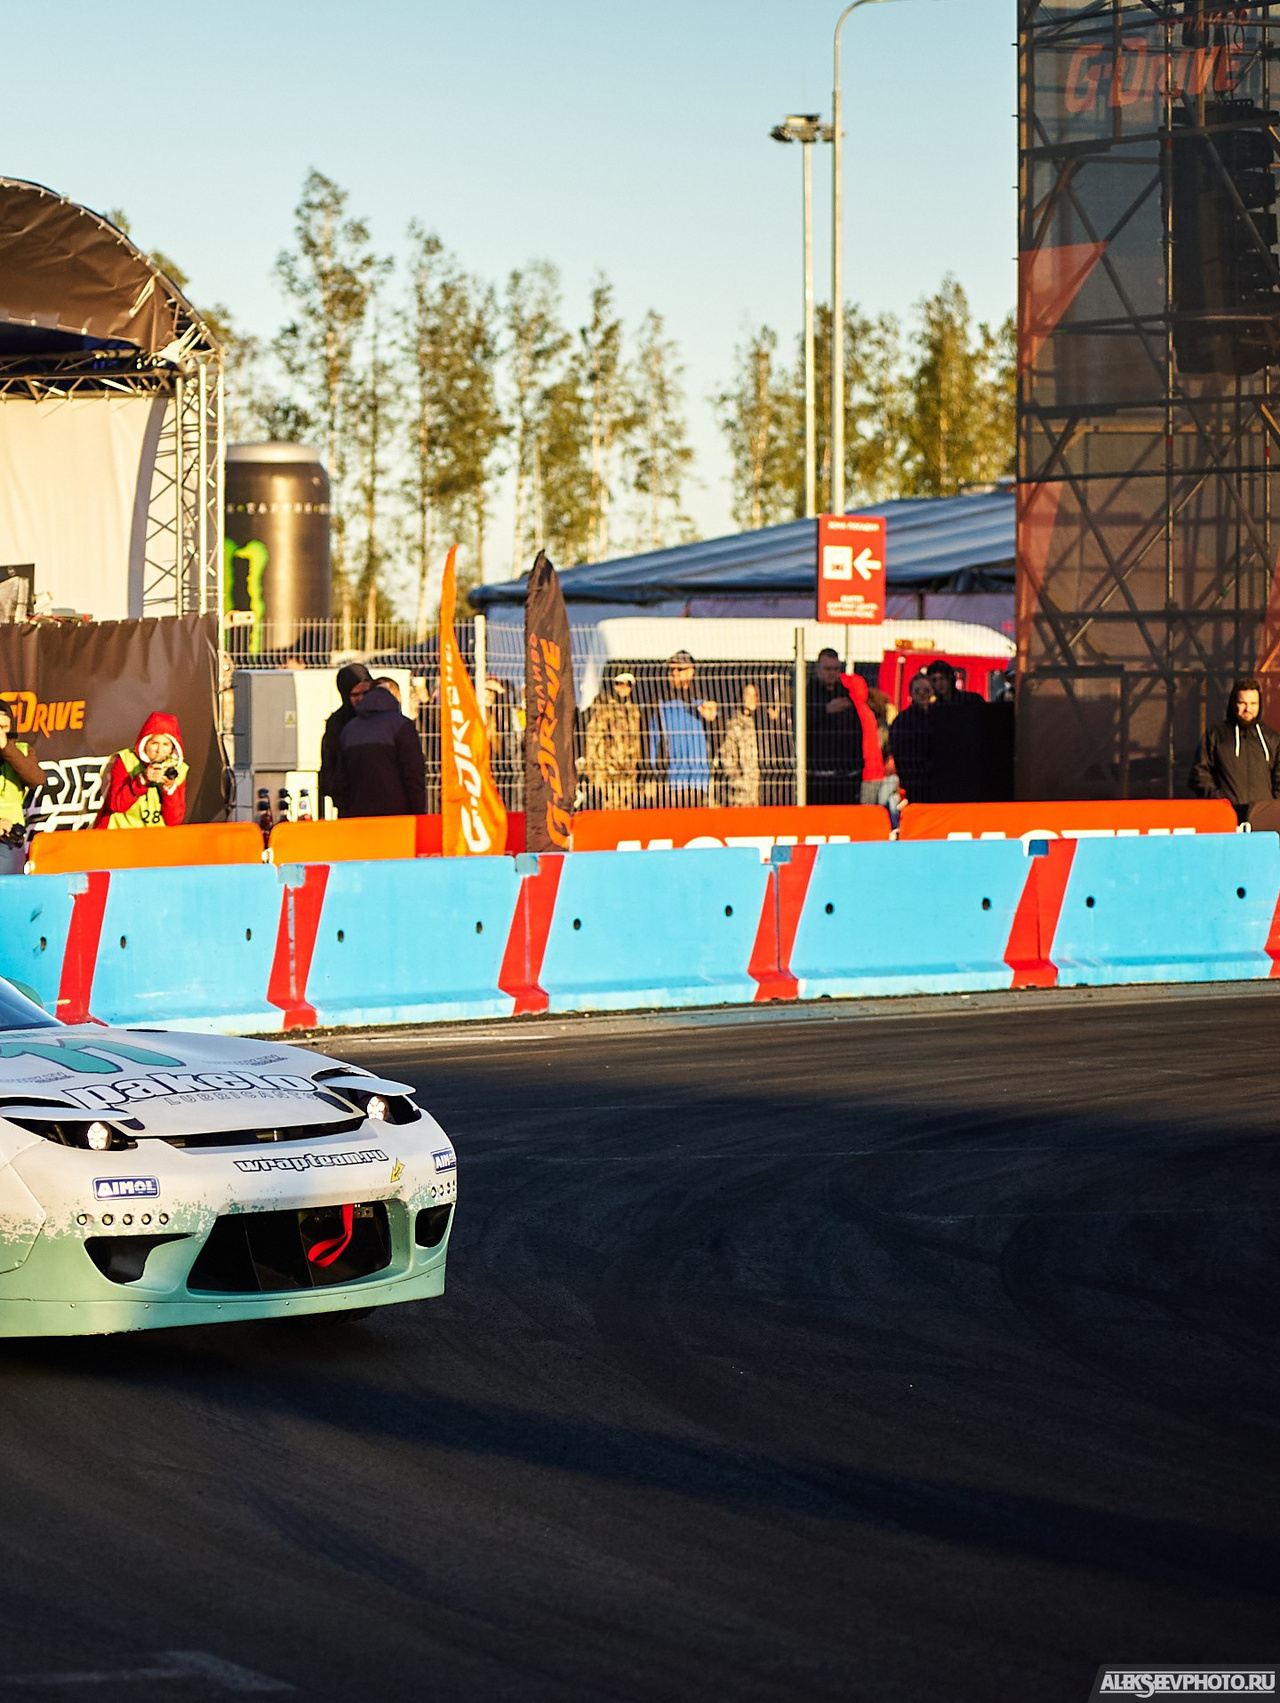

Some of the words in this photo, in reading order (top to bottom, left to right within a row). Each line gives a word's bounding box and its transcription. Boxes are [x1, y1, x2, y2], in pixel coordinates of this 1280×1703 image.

[142, 808, 161, 824] 28
[60, 1070, 320, 1111] pakelo
[166, 1089, 320, 1106] LUBRICANTS
[233, 1149, 390, 1172] wrapteam.ru
[96, 1179, 158, 1196] AIMOL
